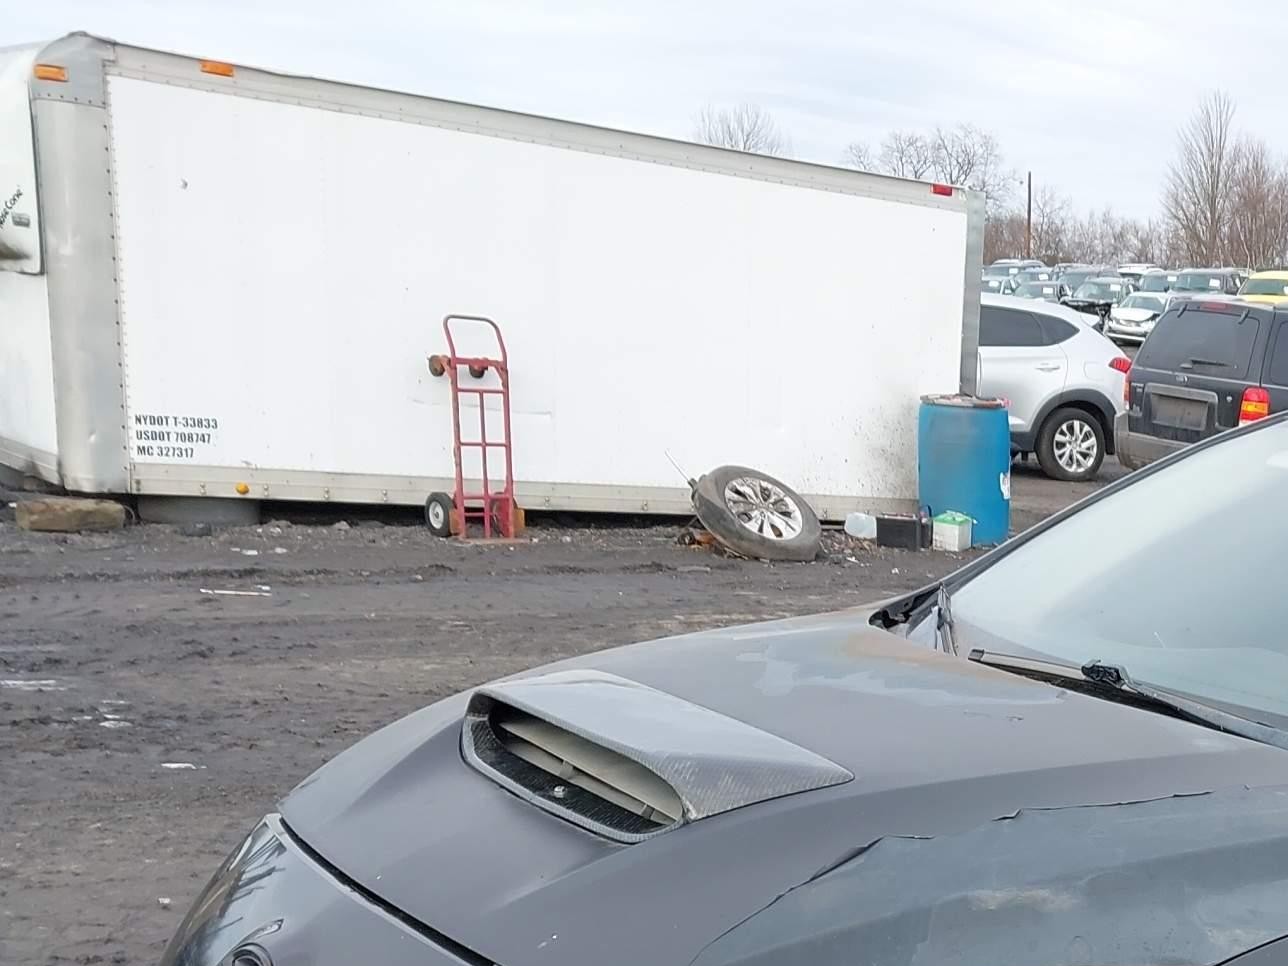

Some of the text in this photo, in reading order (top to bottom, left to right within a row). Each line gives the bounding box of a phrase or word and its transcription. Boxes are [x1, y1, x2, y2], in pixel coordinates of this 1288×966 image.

[134, 414, 218, 429] NYDOT T-33833
[135, 429, 211, 444] USDOT 708747
[136, 445, 194, 458] MC 327317
